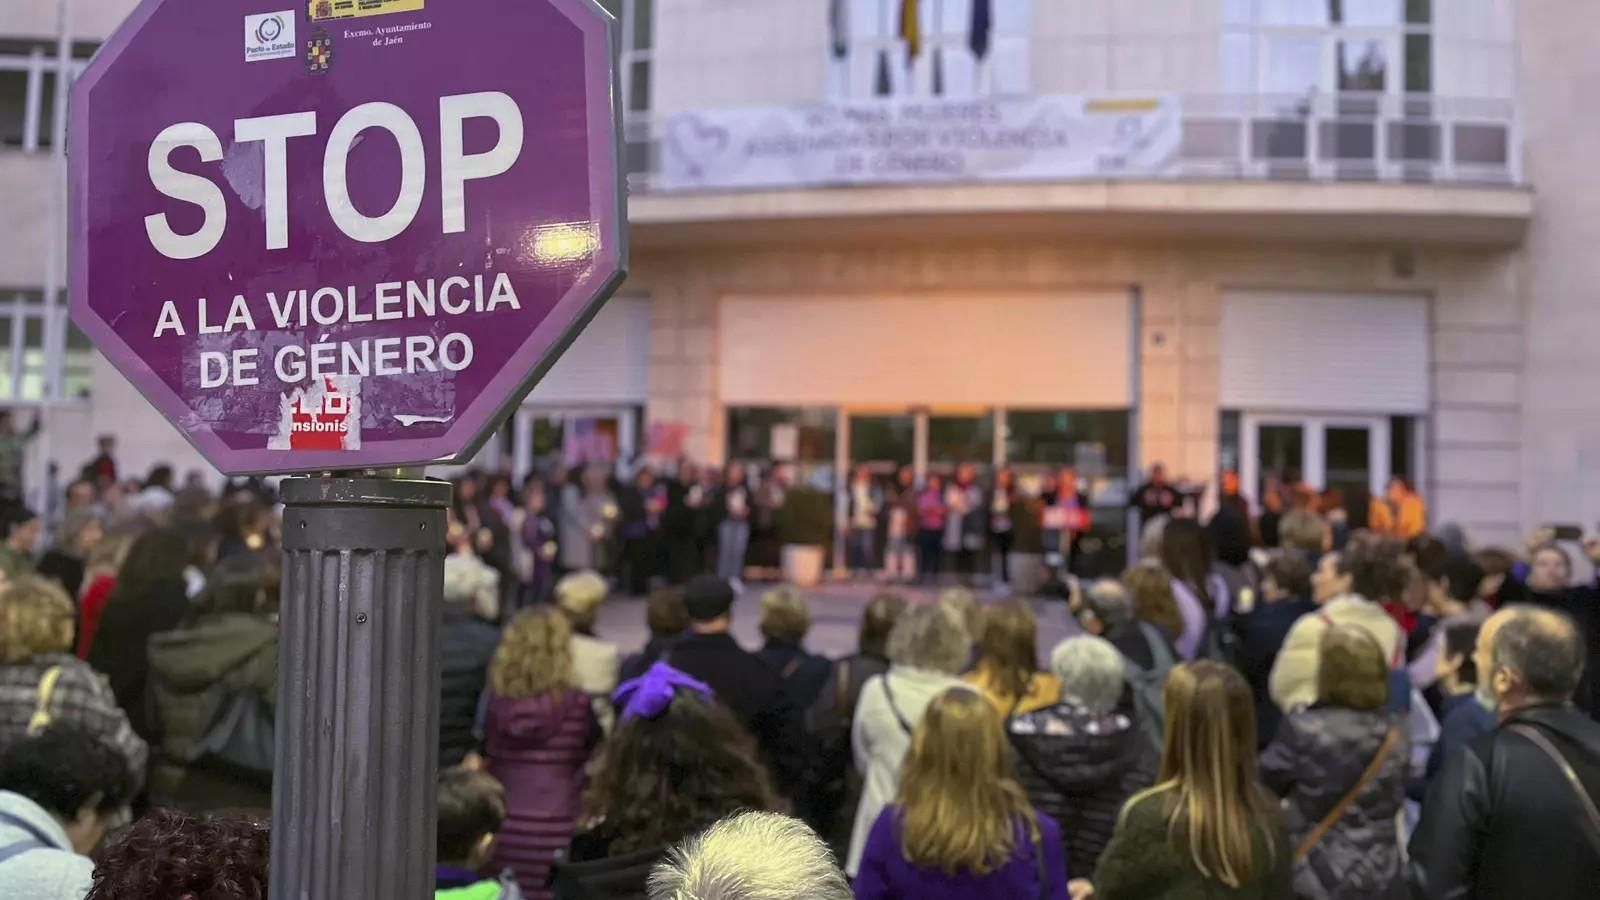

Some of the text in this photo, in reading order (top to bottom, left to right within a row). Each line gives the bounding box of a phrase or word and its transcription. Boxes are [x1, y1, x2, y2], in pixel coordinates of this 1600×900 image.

[343, 21, 432, 39] Excmo. Ayuntamiento
[372, 36, 404, 46] de Jaén
[145, 92, 524, 259] STOP
[153, 272, 521, 338] A LA VIOLENCIA
[199, 332, 474, 389] DE GÉNERO
